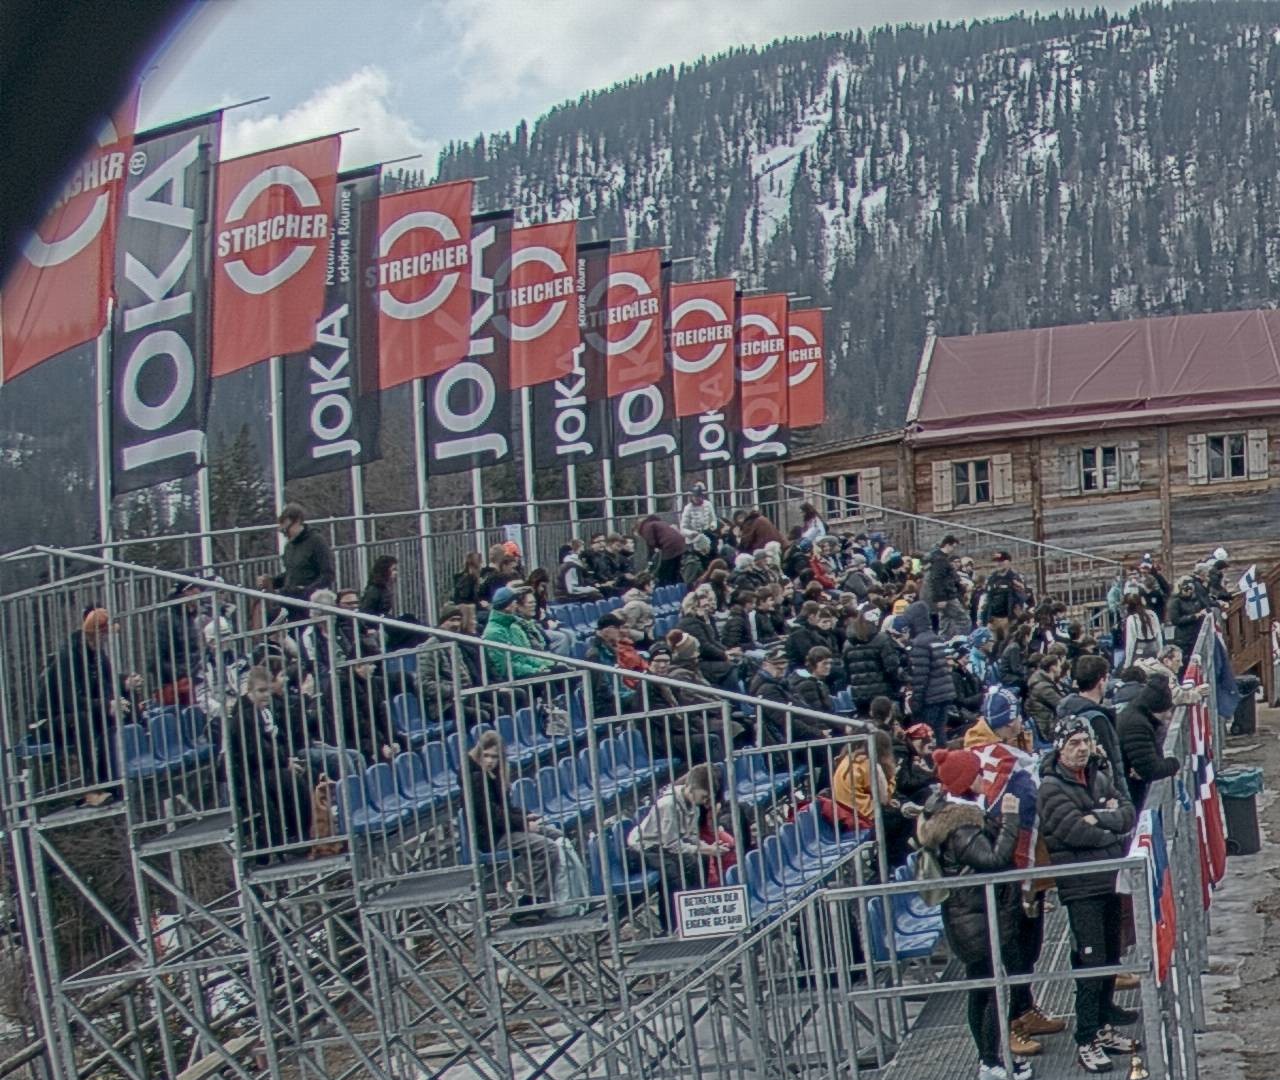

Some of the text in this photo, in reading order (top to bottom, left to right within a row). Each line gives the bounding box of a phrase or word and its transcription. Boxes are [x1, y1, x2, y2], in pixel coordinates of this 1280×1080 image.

[216, 213, 329, 258] STREICHER
[365, 244, 469, 288] STREICHER
[122, 135, 208, 470] JOKA
[742, 338, 785, 358] EICHER
[310, 303, 362, 459] JOKA
